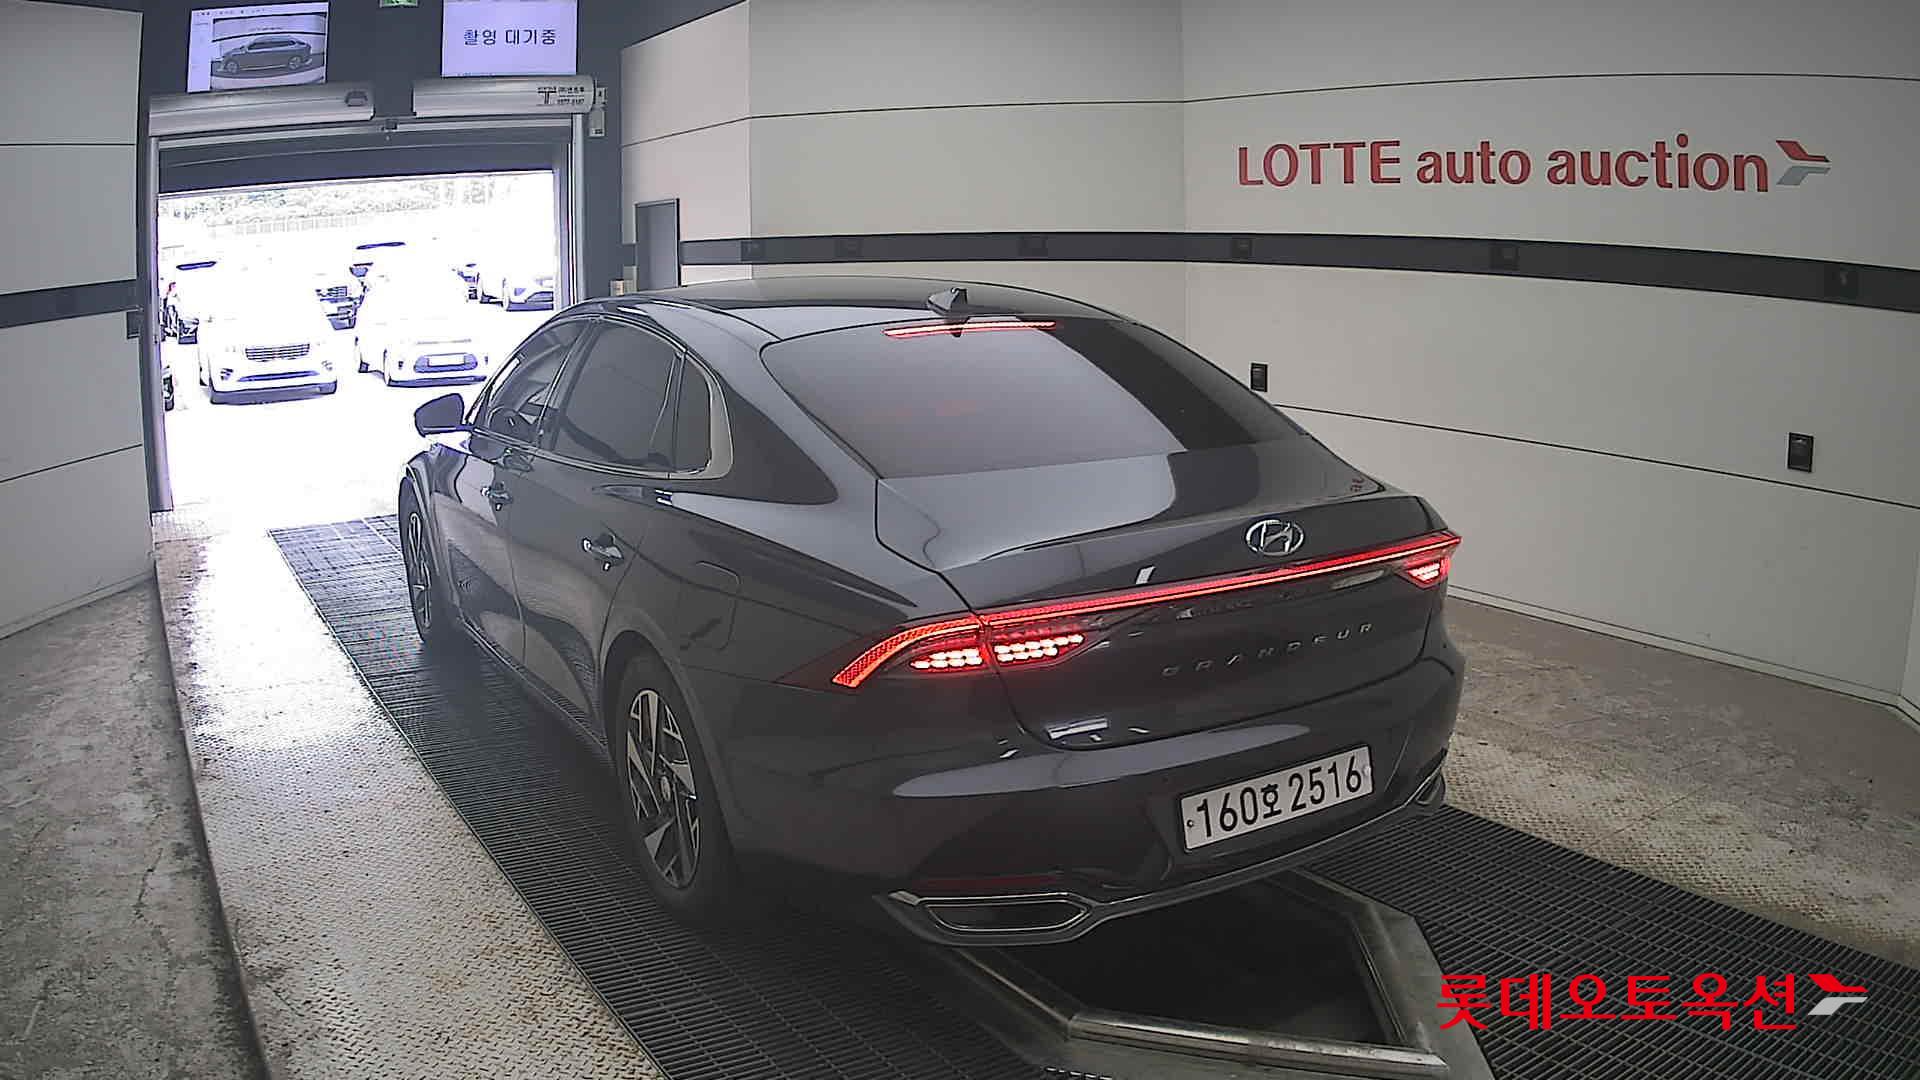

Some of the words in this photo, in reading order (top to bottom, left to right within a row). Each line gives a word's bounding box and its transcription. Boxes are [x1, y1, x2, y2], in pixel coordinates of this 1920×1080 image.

[505, 28, 557, 46] 대기중
[1238, 139, 1401, 187] LOTTE
[1416, 140, 1532, 185] auto
[1546, 132, 1769, 193] auction
[1161, 622, 1373, 677] GRANDEUR
